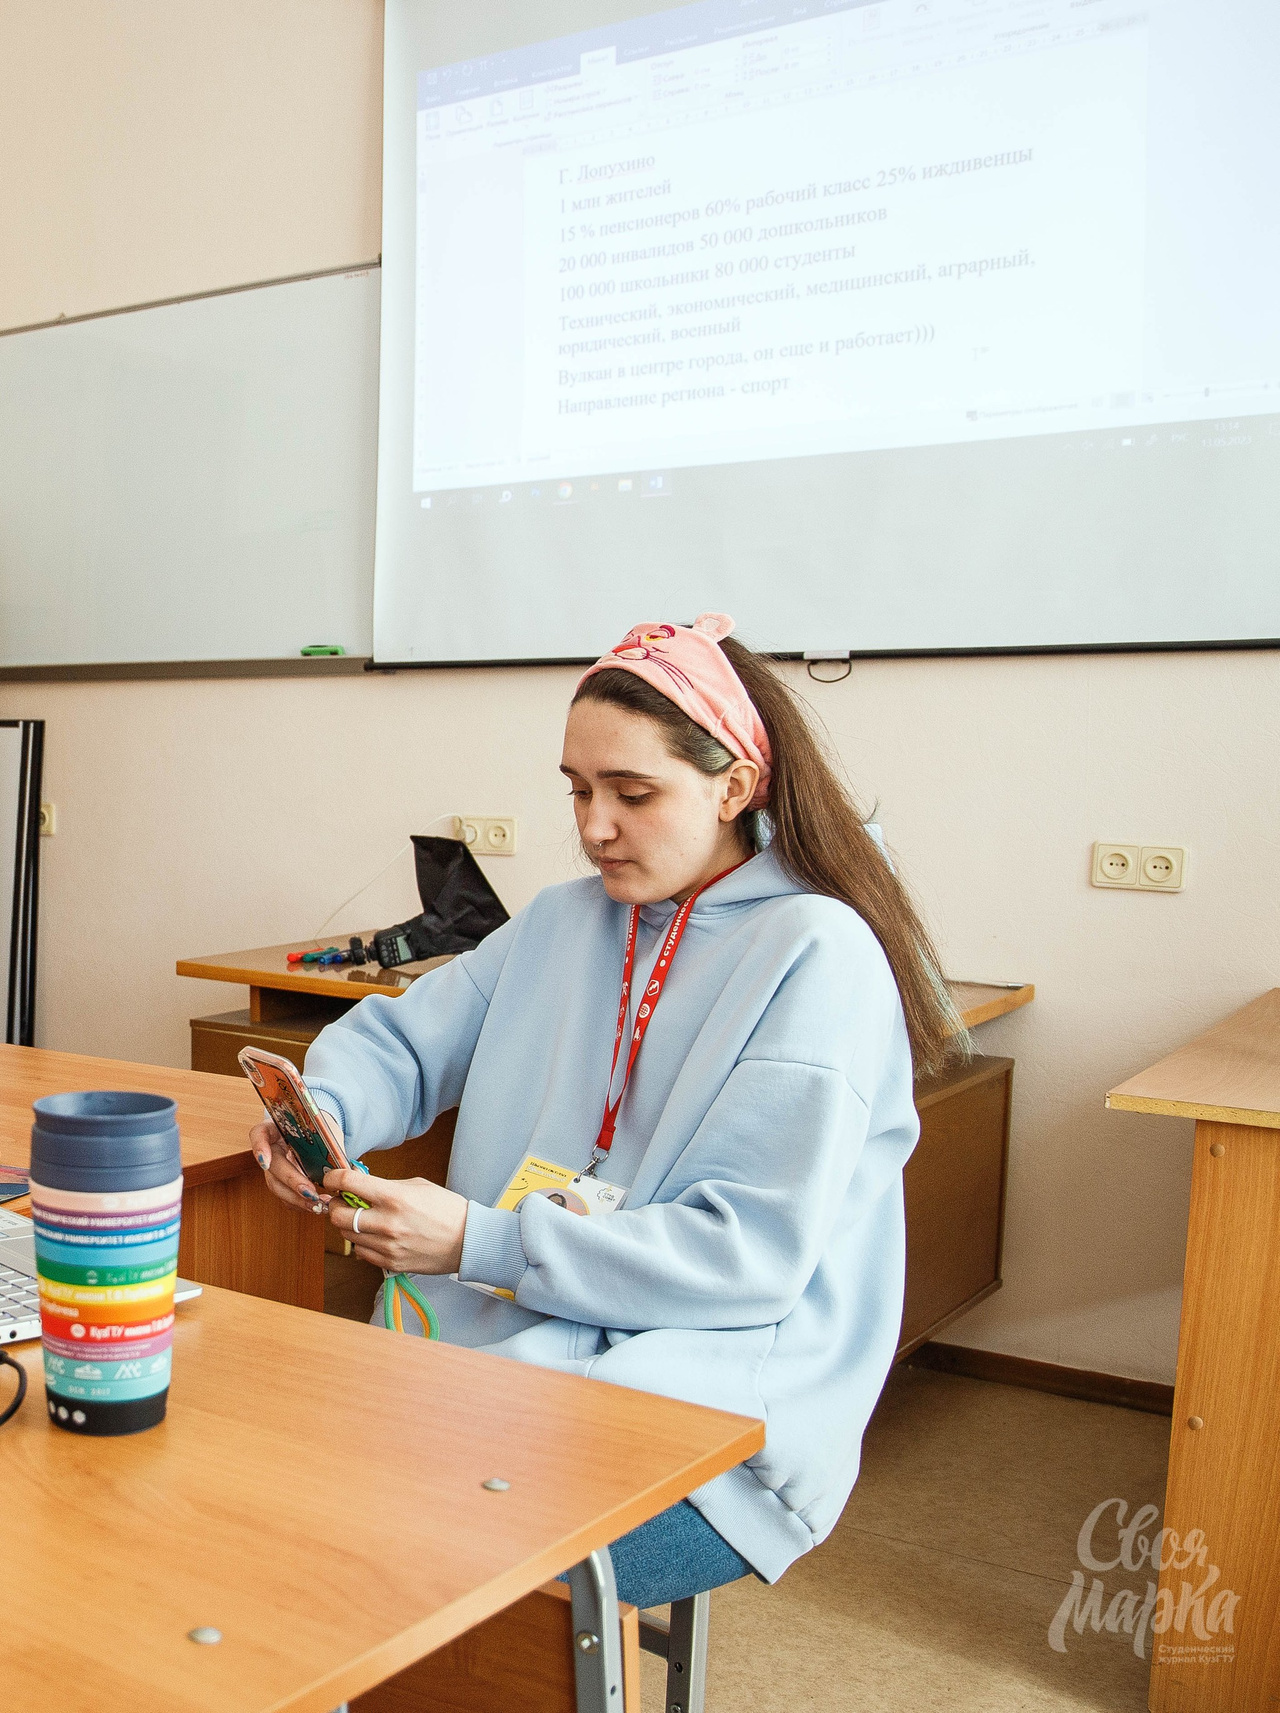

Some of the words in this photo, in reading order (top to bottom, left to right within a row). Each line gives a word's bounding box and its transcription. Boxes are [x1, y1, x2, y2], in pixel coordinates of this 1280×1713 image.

[558, 169, 573, 185] Г.
[577, 155, 656, 181] Лопухино
[560, 226, 576, 243] 15
[580, 223, 595, 238] %
[600, 207, 700, 237] пенсионеров
[705, 197, 741, 217] 60%
[746, 183, 817, 214] рабочий
[823, 176, 871, 197] класс
[876, 165, 916, 188] 25%
[921, 147, 1034, 180] иждивенцы
[560, 197, 566, 214] 1
[571, 195, 601, 212] млн
[606, 178, 672, 206] жителей
[558, 256, 576, 274] 20
[580, 251, 607, 269] 000
[611, 239, 694, 265] инвалидов
[699, 232, 718, 250] 50
[723, 226, 753, 245] 000
[757, 207, 888, 242] дошкольников
[558, 303, 662, 332] Технический,
[667, 282, 800, 317] экономический,
[806, 263, 933, 297] медицинский,
[938, 249, 1036, 280] аграрный,
[560, 285, 585, 302] 100
[589, 279, 616, 297] 000
[620, 268, 709, 294] школьники
[715, 261, 734, 279] 80
[738, 255, 768, 274] 000
[774, 245, 856, 271] студенты
[558, 328, 666, 358] юридический,
[670, 316, 742, 341] военный
[558, 368, 613, 388] Вулкан
[617, 366, 626, 378] в
[630, 357, 684, 377] центре
[688, 351, 749, 372] города,
[753, 347, 774, 362] он
[779, 340, 814, 358] еще
[819, 340, 830, 353] и
[834, 323, 936, 356] работает)))
[558, 391, 657, 416] Направление
[661, 383, 725, 408] региона
[741, 376, 791, 396] спорт
